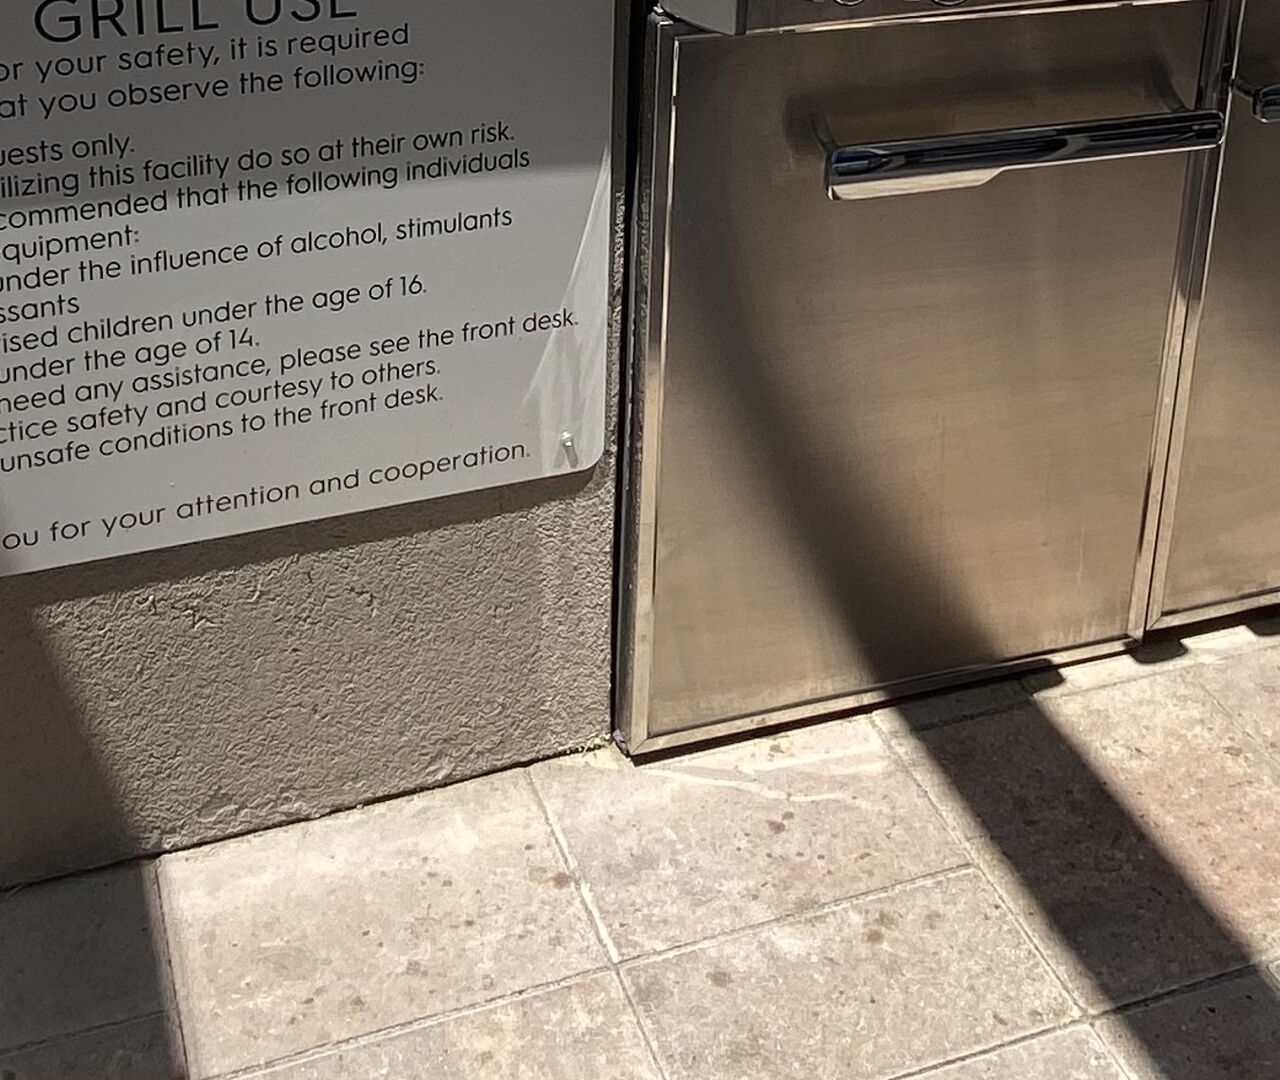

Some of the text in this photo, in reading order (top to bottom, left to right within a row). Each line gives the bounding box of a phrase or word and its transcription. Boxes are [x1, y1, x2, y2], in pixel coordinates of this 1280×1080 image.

[34, 54, 107, 84] your
[118, 41, 220, 71] safety,
[230, 37, 248, 60] it
[257, 36, 278, 58] is
[287, 22, 409, 56] required
[38, 92, 96, 120] you
[107, 79, 229, 108] observe
[239, 72, 284, 95] the
[292, 60, 424, 89] following:
[71, 132, 135, 160] only.
[88, 164, 135, 188] this
[142, 153, 230, 182] facility
[237, 148, 273, 171] do
[280, 147, 310, 166] so
[318, 138, 344, 162] at
[351, 133, 406, 158] their
[412, 130, 463, 151] own
[471, 120, 514, 145] risk.
[176, 182, 230, 209] that
[237, 178, 278, 202] the
[285, 166, 398, 196] following
[406, 148, 530, 182] individuals
[78, 259, 122, 282] the
[130, 244, 248, 275] influence
[256, 234, 284, 258] of
[290, 222, 388, 254] alcohol,
[396, 206, 512, 240] stimulants
[67, 314, 173, 344] children
[182, 301, 258, 328] under
[264, 294, 304, 316] the
[312, 287, 360, 312] age
[368, 277, 394, 300] of
[400, 274, 427, 296] 16.
[74, 380, 124, 402] any
[132, 358, 271, 393] assistance,
[280, 344, 361, 376] please
[369, 336, 410, 356] see
[418, 328, 454, 349] the
[461, 316, 516, 342] front
[522, 308, 578, 333] desk.
[84, 349, 126, 372] the
[134, 341, 187, 366] age
[195, 330, 222, 355] of
[228, 327, 260, 350] 14.
[0, 440, 90, 472] unsafe
[98, 420, 234, 456] conditions
[241, 413, 266, 433] to
[274, 406, 312, 428] the
[320, 392, 378, 420] front
[384, 383, 443, 409] desk.
[66, 403, 149, 433] safety
[156, 390, 206, 418] and
[215, 378, 324, 409] courtesy
[330, 370, 354, 390] to
[361, 360, 440, 386] others.
[49, 520, 91, 542] for
[101, 507, 166, 538] your
[176, 484, 300, 520] attention
[309, 468, 360, 496] and
[369, 444, 530, 484] cooperation.
